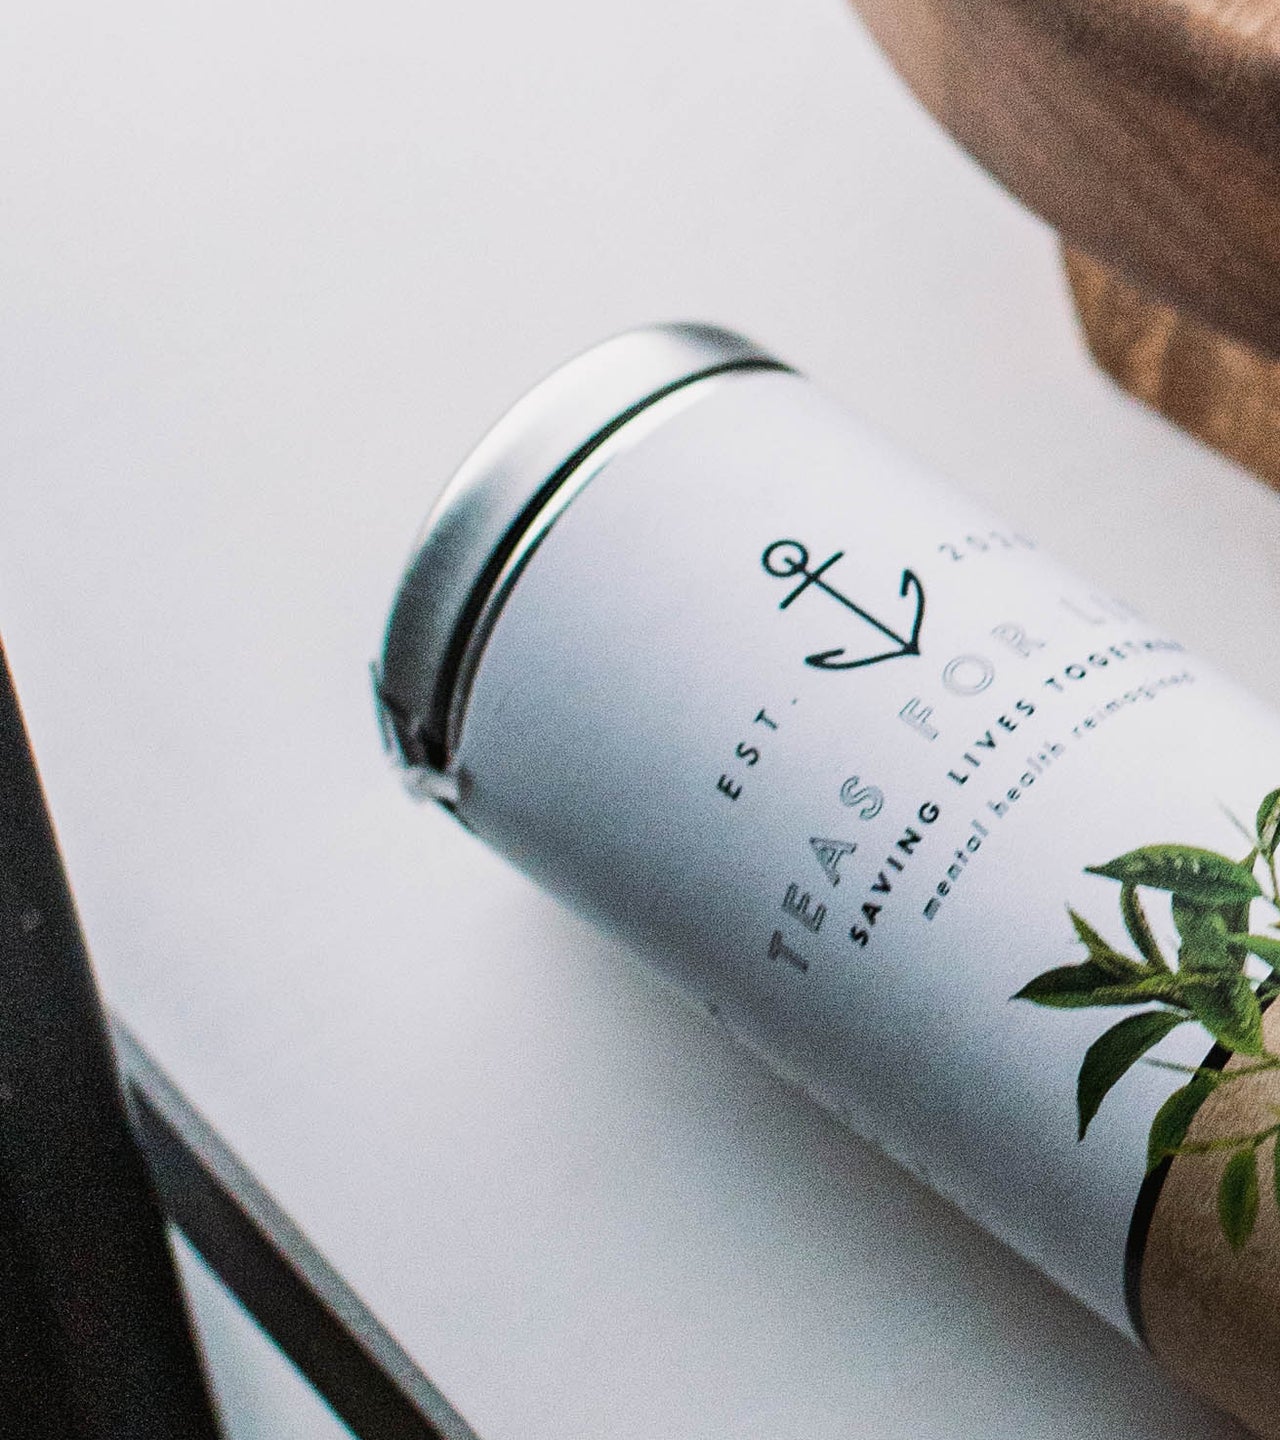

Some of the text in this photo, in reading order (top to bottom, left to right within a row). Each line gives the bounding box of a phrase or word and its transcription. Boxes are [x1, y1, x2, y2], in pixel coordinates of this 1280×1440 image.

[767, 775, 885, 972] TEAS
[899, 621, 1046, 741] FOR
[849, 801, 941, 948] SAVING
[946, 698, 1037, 785] LIVES
[922, 819, 989, 921] mental
[986, 738, 1066, 818] health
